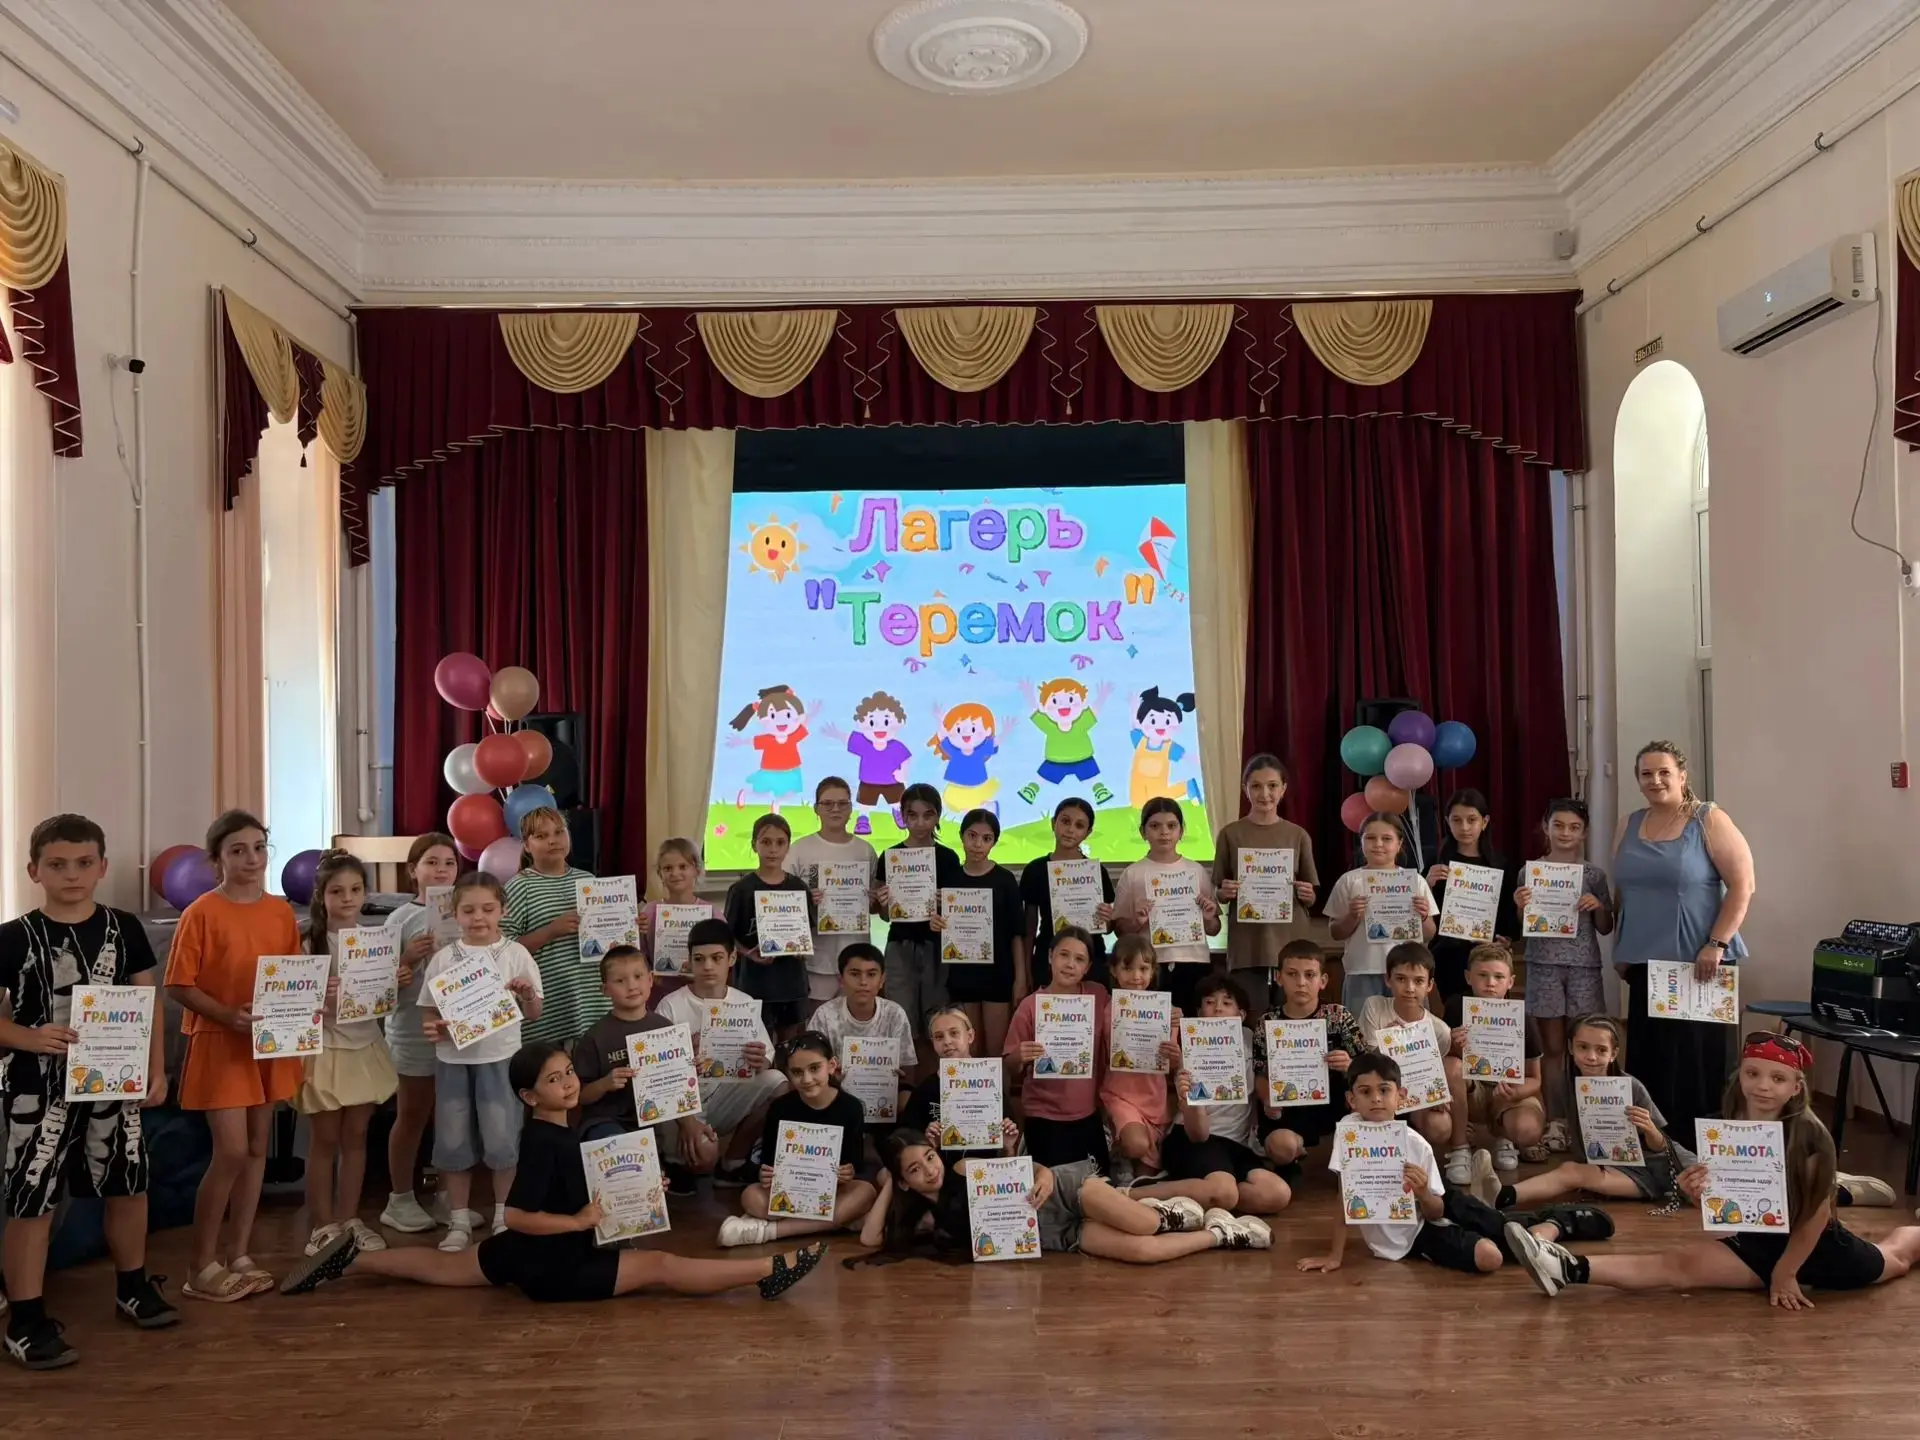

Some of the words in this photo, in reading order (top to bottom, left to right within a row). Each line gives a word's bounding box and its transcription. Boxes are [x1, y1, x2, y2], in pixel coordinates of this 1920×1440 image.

[1637, 340, 1664, 361] ВЫХОД
[849, 498, 1083, 563] Лагерь
[1246, 865, 1287, 874] ГРАМОТА
[1057, 876, 1095, 886] ГРАМОТА
[1454, 880, 1494, 892] ГРАМОТА
[1534, 878, 1575, 889] ГРАМОТА
[1154, 886, 1194, 896] ГРАМОТА
[1371, 885, 1412, 893] ГРАМОТА
[586, 894, 629, 905] ГРАМОТА
[949, 905, 987, 913] ГРАМОТА
[348, 945, 393, 959] ГРАМОТА
[265, 980, 318, 992] ГРАМОТА
[441, 967, 490, 996] ГРАМОТА
[1668, 968, 1678, 1012] ГРАМОТА
[84, 1010, 143, 1023] ГРАМОТА
[1045, 1013, 1087, 1022] ГРАМОТА
[1120, 1009, 1164, 1020] ГРАМОТА
[711, 1018, 753, 1027] ГРАМОТА
[1472, 1016, 1517, 1026] ГРАМОТА
[1191, 1036, 1235, 1046] ГРАМОТА
[1276, 1038, 1320, 1048] ГРАМОТА
[1388, 1039, 1430, 1056] ГРАМОТА
[639, 1048, 686, 1067] ГРАМОТА
[851, 1056, 892, 1065] ГРАМОТА
[950, 1079, 995, 1088] ГРАМОТА
[1585, 1096, 1624, 1105] ГРАМОТА
[785, 1144, 833, 1157] ГРАМОТА
[1348, 1147, 1401, 1158] ГРАМОТА
[1710, 1144, 1774, 1157] ГРАМОТА
[598, 1153, 645, 1172] ГРАМОТА
[977, 1183, 1026, 1196] ГРАМОТА
